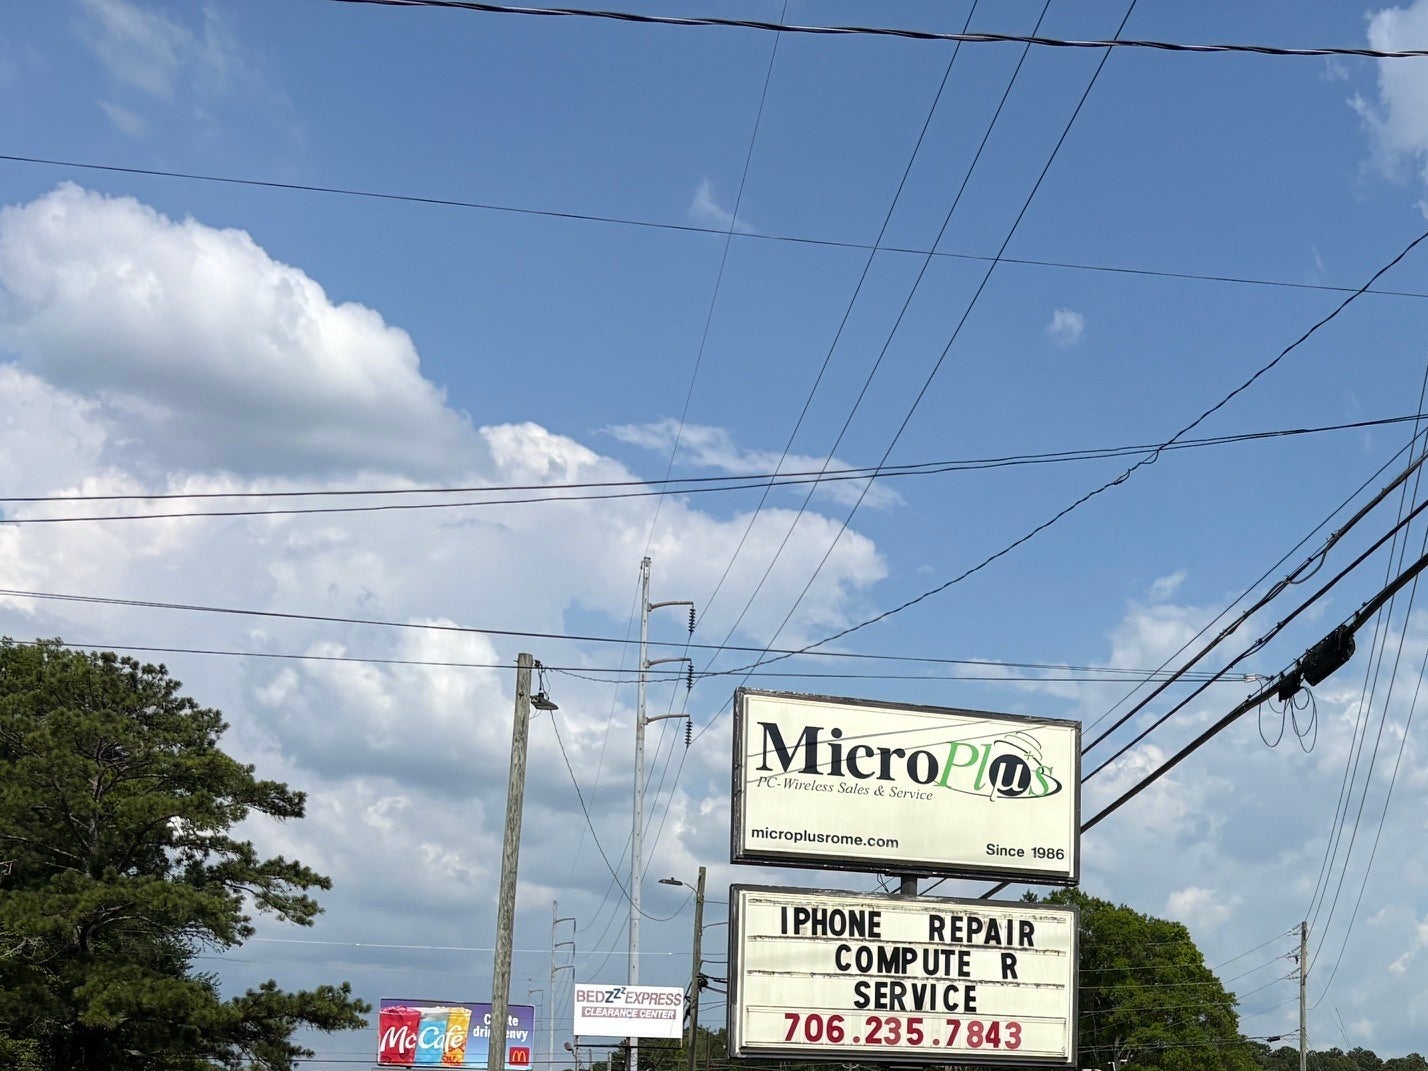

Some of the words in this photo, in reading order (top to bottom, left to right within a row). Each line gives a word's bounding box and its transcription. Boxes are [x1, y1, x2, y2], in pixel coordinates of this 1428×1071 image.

[757, 775, 834, 793] PC-Wireless
[838, 781, 869, 796] Sales
[874, 785, 885, 797] &
[889, 786, 933, 801] Service
[751, 827, 899, 848] microplusrome.com
[985, 843, 1025, 858] Since
[1031, 846, 1065, 860] 1986
[780, 906, 882, 938] IPHONE
[928, 914, 1035, 946] REPAIR
[624, 992, 682, 1006] EXPRESS
[853, 981, 977, 1012] SERVICE
[584, 1007, 638, 1018] CLEARANCE
[640, 1009, 675, 1019] CENTER
[783, 1012, 1022, 1050] 706.235.7843
